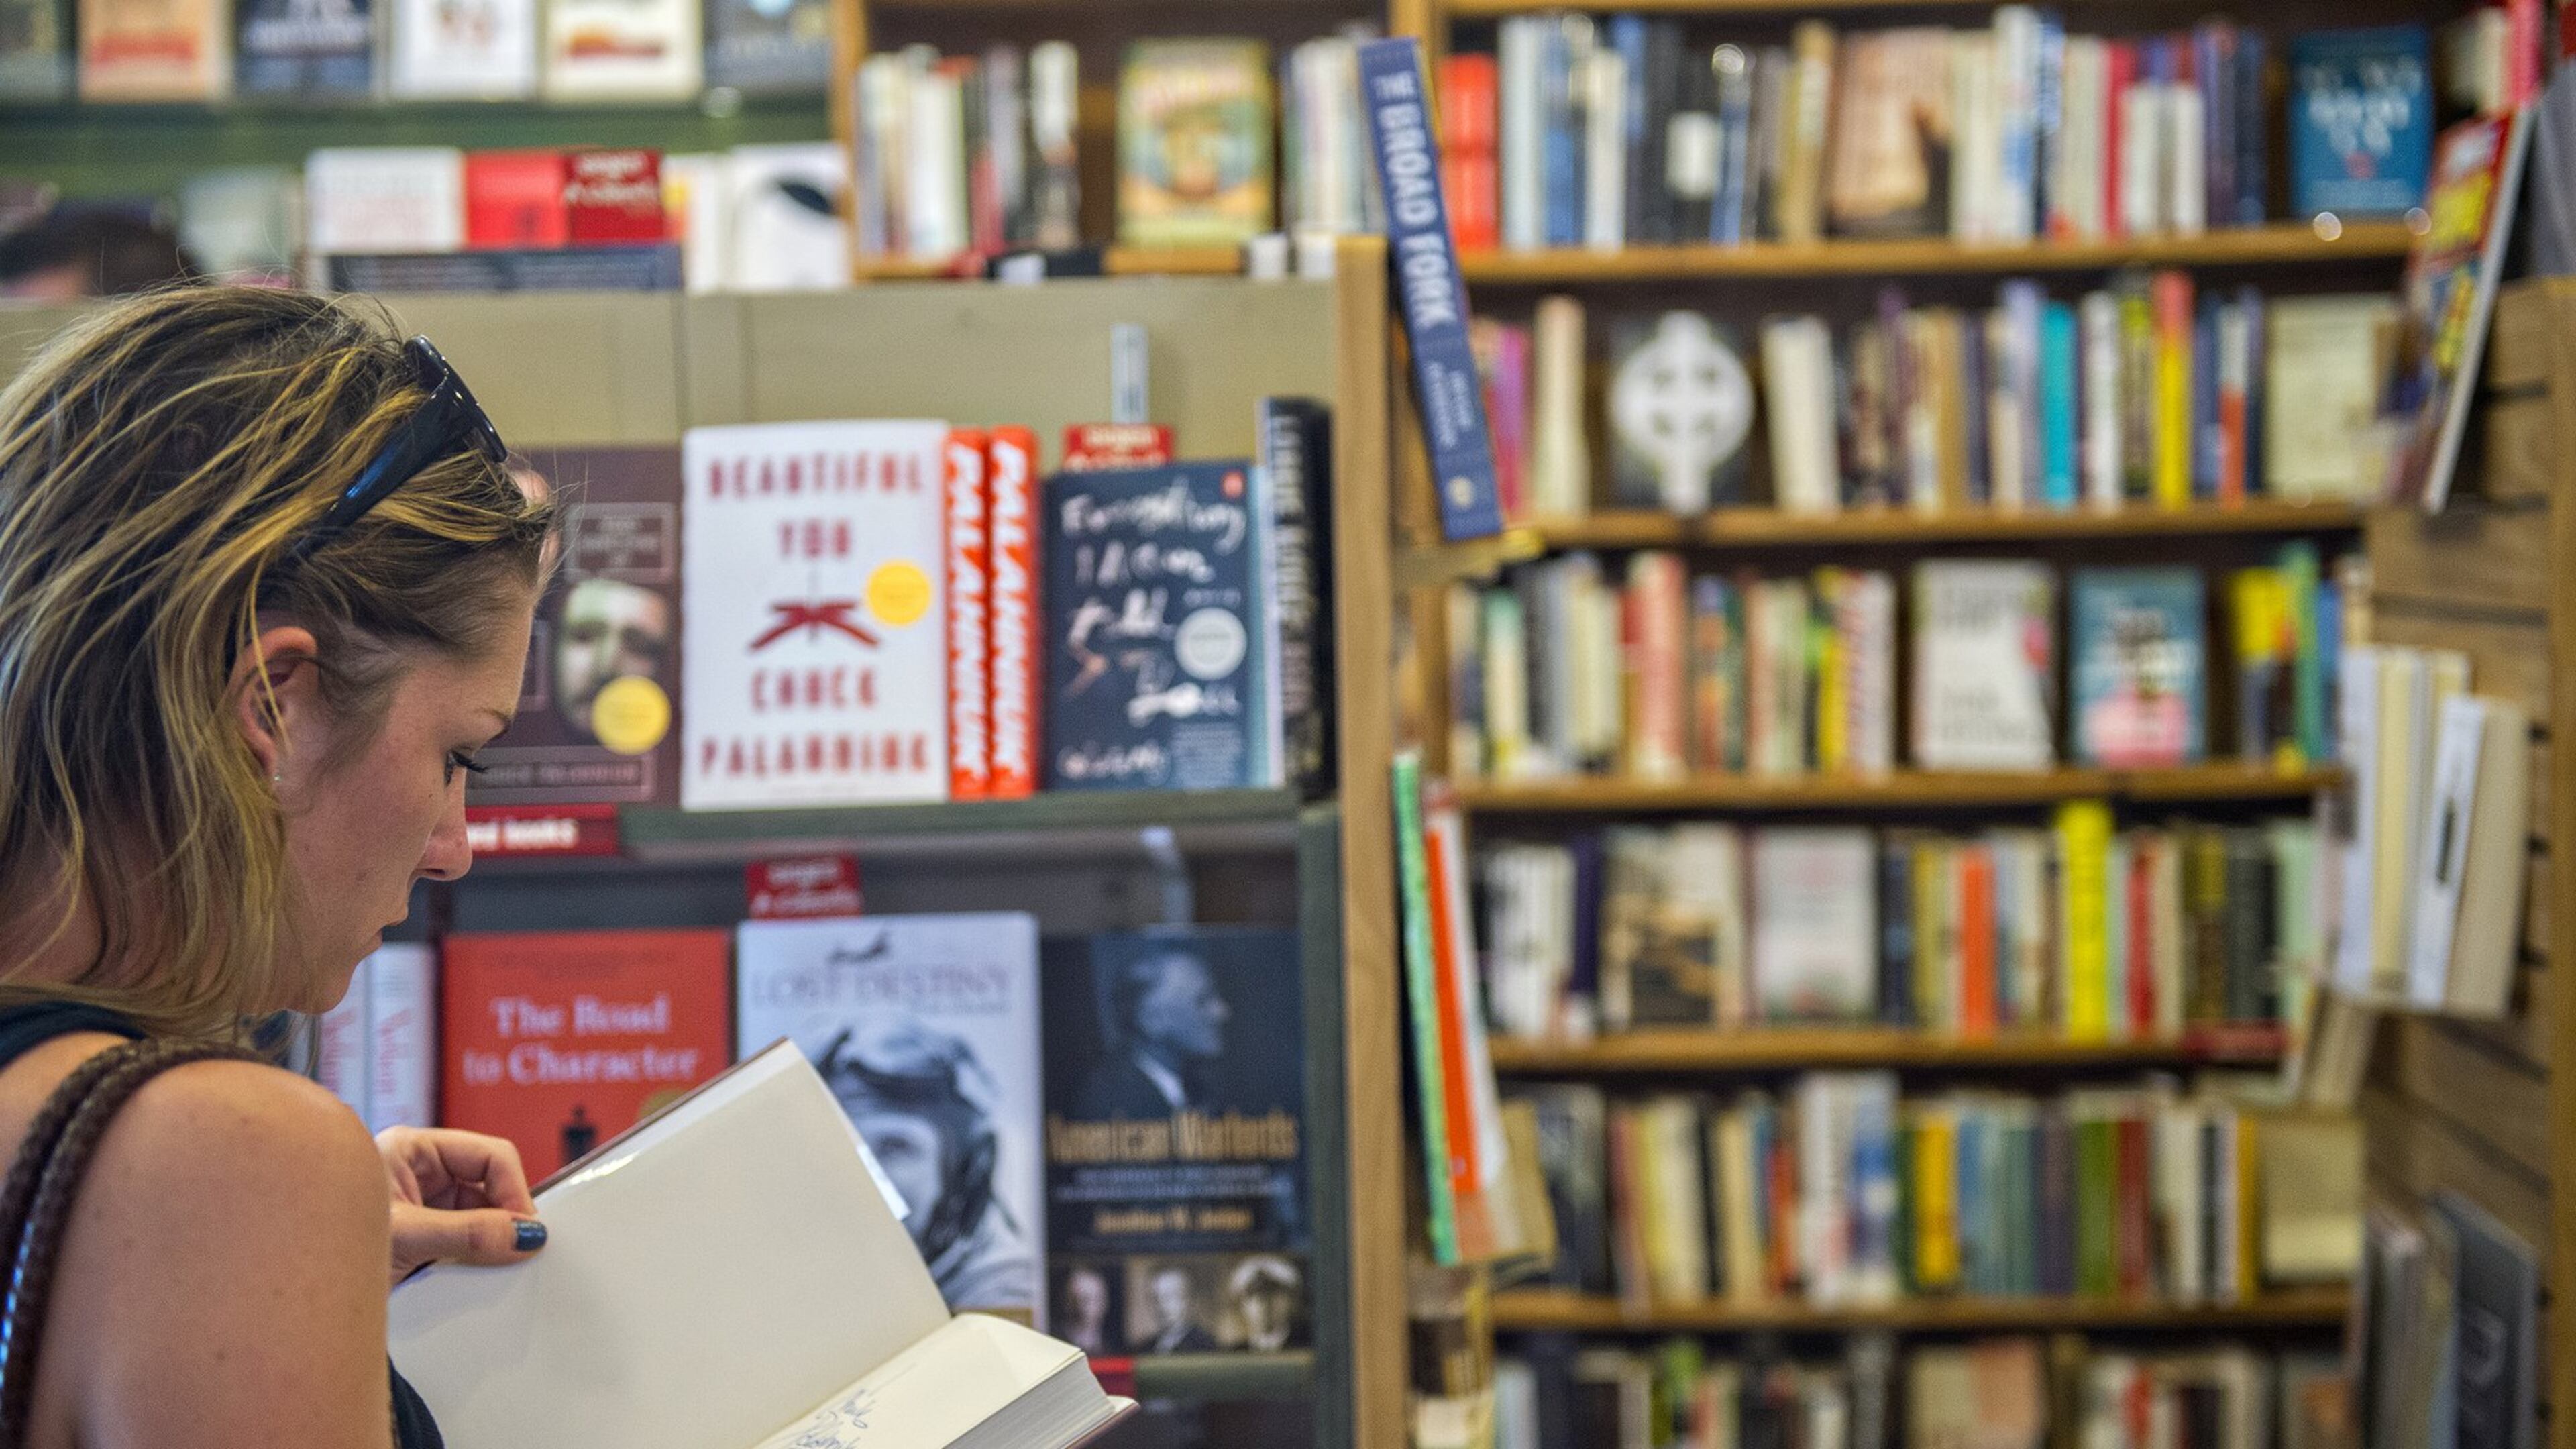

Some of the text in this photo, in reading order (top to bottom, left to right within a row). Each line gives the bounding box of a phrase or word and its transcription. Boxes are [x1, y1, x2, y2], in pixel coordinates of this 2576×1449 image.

[1377, 103, 1440, 228] BROAD
[1403, 231, 1458, 330] FORK
[708, 452, 922, 497] BEAUTIFUL
[777, 517, 854, 559] YOU
[1060, 477, 1248, 557] Everything
[947, 441, 985, 780] PALAHNIUK
[991, 438, 1030, 780] PALAHNIUK
[751, 667, 877, 712] CHUCK
[701, 734, 930, 778] PALAHNIUK
[852, 964, 1010, 998] DESTINY
[490, 991, 669, 1037] The Road
[463, 1041, 699, 1085] to Character
[1047, 1106, 1297, 1164] American Warlords
